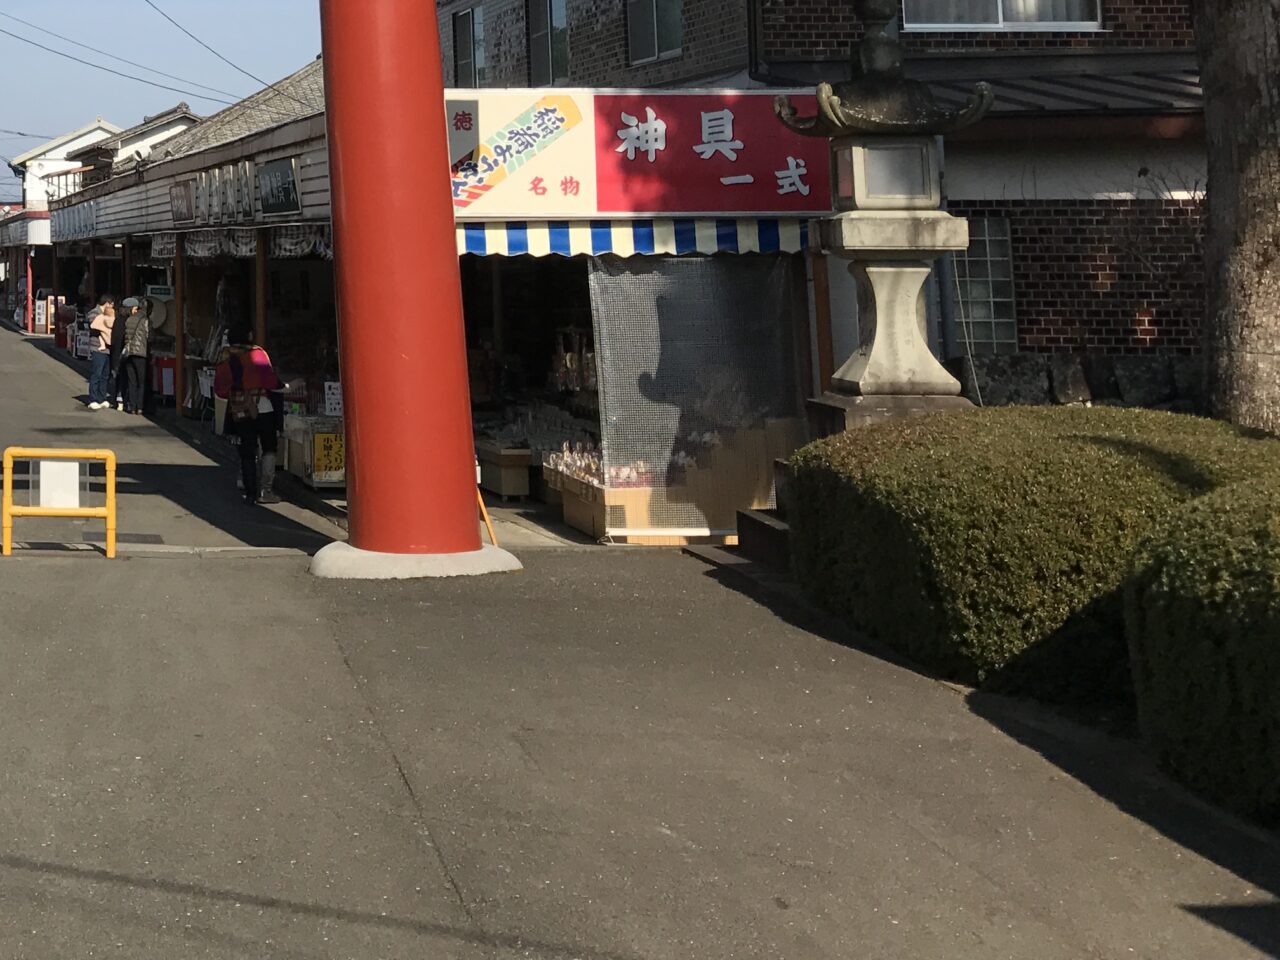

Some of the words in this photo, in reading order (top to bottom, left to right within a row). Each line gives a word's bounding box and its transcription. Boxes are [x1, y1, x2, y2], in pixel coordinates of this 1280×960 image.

[614, 106, 745, 163] 神具
[527, 175, 581, 197] 名物
[720, 156, 810, 197] 一式
